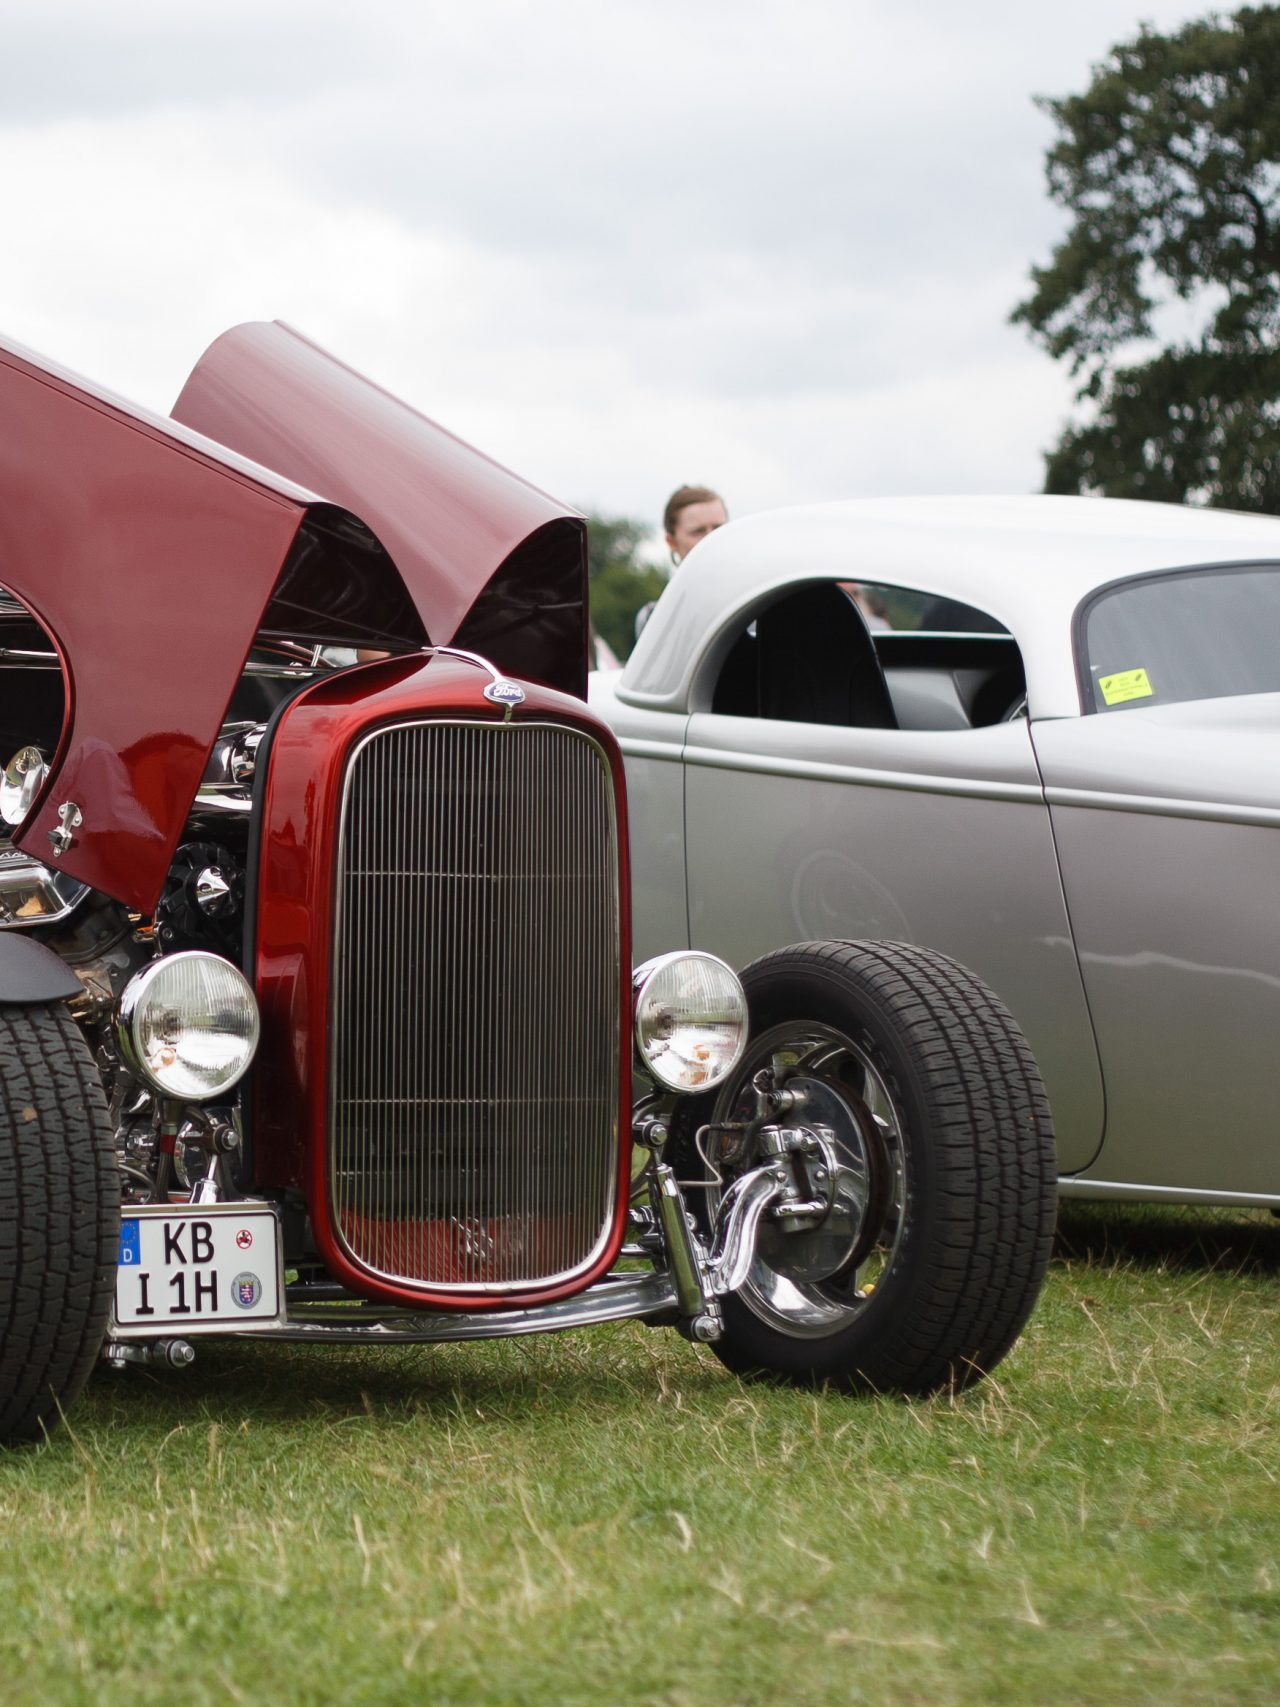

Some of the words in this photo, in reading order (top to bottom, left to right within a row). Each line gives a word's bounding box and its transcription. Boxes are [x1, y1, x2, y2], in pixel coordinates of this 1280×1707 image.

[493, 683, 522, 698] Ford
[123, 1248, 133, 1263] D
[163, 1221, 215, 1265] KB
[169, 1270, 218, 1314] 1H
